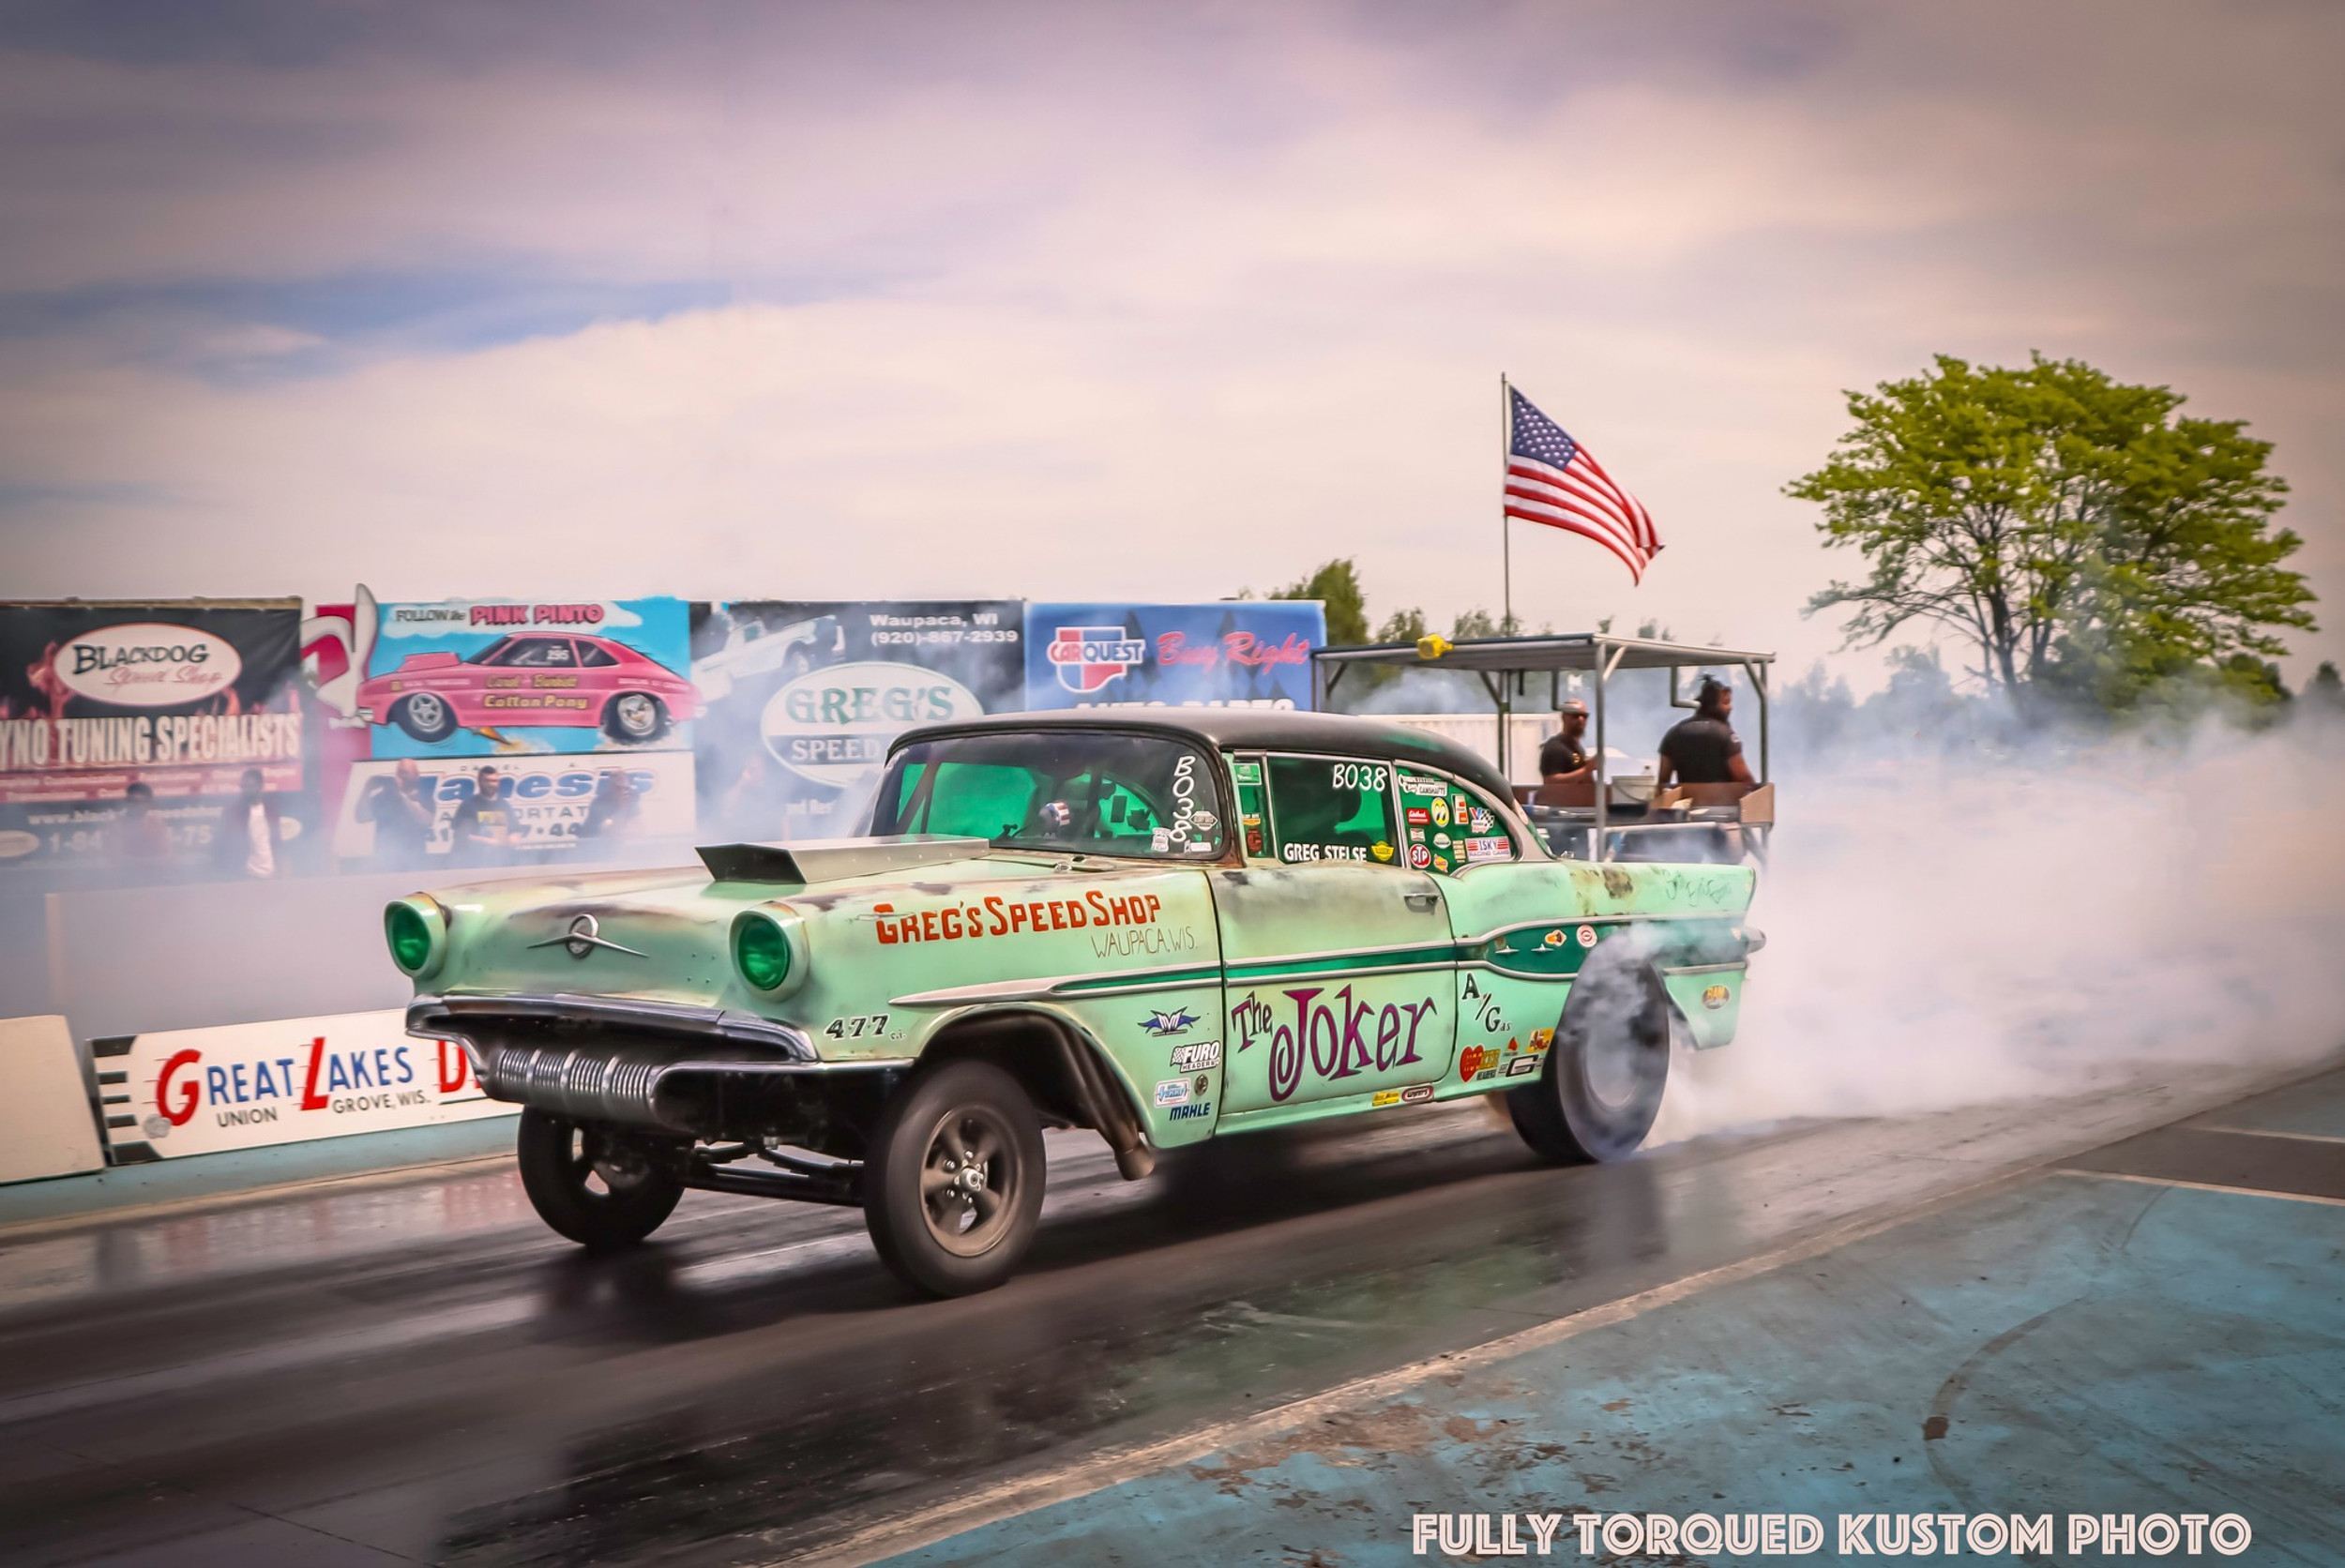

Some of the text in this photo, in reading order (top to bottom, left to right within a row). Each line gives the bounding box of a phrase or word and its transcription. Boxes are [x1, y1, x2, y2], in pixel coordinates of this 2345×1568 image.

[395, 609, 448, 622] FOLLOW
[470, 606, 528, 626] PINK
[533, 603, 605, 625] PINTO
[870, 612, 998, 628] Waupaca, WI
[1049, 641, 1144, 663] CARQUEST
[1156, 630, 1310, 675] Buy Right
[543, 693, 589, 710] Pony
[784, 685, 955, 726] GREG'S
[54, 716, 152, 764] TUNING
[155, 713, 302, 762] SPECIALISTS
[790, 738, 880, 761] SPEED
[1283, 842, 1320, 862] GREG
[1412, 846, 1429, 863] STP
[1478, 839, 1497, 851] ISKY
[873, 889, 1162, 944] GREG'S SPEED SHOP
[824, 1014, 889, 1040] 477
[1231, 983, 1438, 1102] The Joker
[1183, 1061, 1217, 1071] HEADERS
[155, 1047, 295, 1127] GREAT
[299, 1036, 415, 1112] LAKES
[216, 1089, 432, 1128] UNION GROVE, WIS.
[1169, 1102, 1211, 1121] MAHLE
